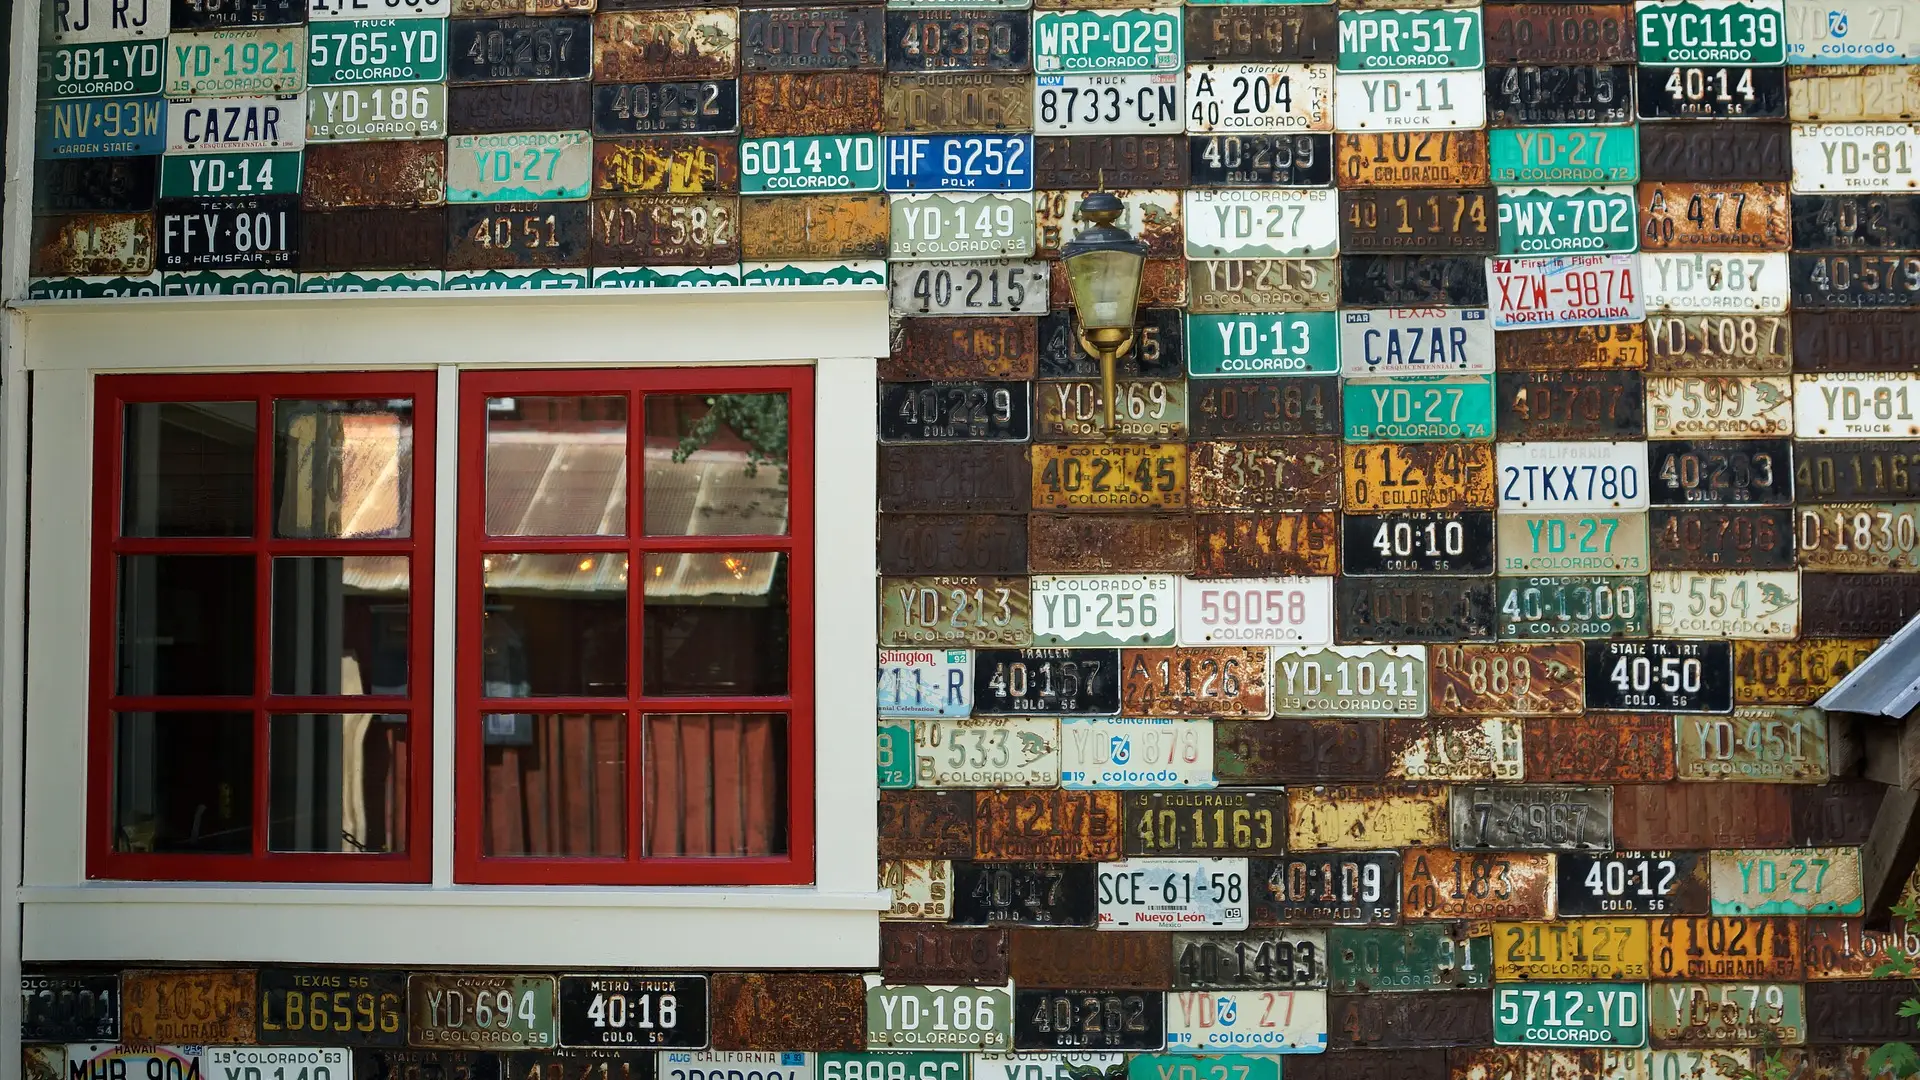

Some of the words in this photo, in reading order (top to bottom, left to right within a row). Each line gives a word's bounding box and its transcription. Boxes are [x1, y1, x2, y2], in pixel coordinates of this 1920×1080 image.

[354, 19, 396, 28] TRUCK
[1642, 13, 1777, 47] EYC1139
[1822, 43, 1895, 53] colorado
[1668, 49, 1751, 60] COLORADO
[1066, 56, 1148, 68] COLORADO
[1367, 55, 1449, 66] COLORADO
[335, 67, 413, 80] COLORADO
[1241, 64, 1289, 74] Colorful
[195, 78, 272, 91] COLORADO
[918, 74, 992, 86] COLORADO
[1040, 77, 1061, 86] NOV
[1089, 77, 1127, 85] TRUCK
[58, 80, 134, 94] COLORADO
[1232, 76, 1292, 114] 204
[184, 106, 280, 143] CAZAR
[1224, 117, 1307, 127] COLORADO
[1387, 117, 1430, 125] TRUCK
[335, 122, 415, 135] COLORADO
[1824, 126, 1907, 136] COLORADO
[478, 135, 558, 148] COLORADO
[58, 145, 99, 154] GARDEN
[103, 142, 133, 153] STATE
[890, 139, 929, 175] HF
[944, 139, 1025, 175] 6252
[1374, 167, 1449, 181] COLORADO
[1521, 168, 1604, 179] COLORADO
[767, 176, 849, 188] COLORADO
[941, 178, 976, 187] POLK
[1845, 178, 1889, 187] TRUCK
[1220, 191, 1304, 202] COLORADO
[201, 201, 257, 210] TEXAS
[1687, 192, 1746, 230] 477
[1521, 237, 1604, 249] COLORADO
[1678, 233, 1763, 244] COLORADO
[917, 240, 1002, 252] COLORADO
[194, 254, 263, 264] HEMISFAIR
[1521, 259, 1547, 268] First
[1571, 255, 1603, 266] Flight
[914, 268, 1025, 307] 40-215
[1497, 269, 1635, 311] XZW-9874
[1220, 295, 1303, 304] COLORADO
[1672, 296, 1753, 307] COLORADO
[1348, 315, 1369, 323] MAR
[1505, 311, 1554, 322] NORTH
[1560, 307, 1629, 319] CAROLINA
[1364, 326, 1467, 365] CAZAR
[1222, 358, 1306, 371] COLORADO
[1683, 378, 1744, 418] 599
[1376, 425, 1460, 436] COLORADO
[1677, 420, 1760, 432] COLORADO
[1846, 424, 1890, 432] TRUCK
[1531, 448, 1610, 458] CALIFORNIA
[1505, 465, 1638, 501] 2TKX780
[1069, 494, 1150, 504] COLORADO
[1382, 490, 1457, 504] COLORADO
[1530, 557, 1613, 568] COLORADO
[934, 577, 977, 585] TRUCK
[1056, 580, 1142, 591] COLORADO
[1530, 577, 1609, 585] COLORFUL
[1688, 577, 1749, 617] 554
[1201, 590, 1305, 625] 59058
[1530, 623, 1611, 634] COLORADO
[1680, 618, 1764, 631] COLORADO
[1212, 629, 1297, 640] COLORADO
[1611, 644, 1645, 654] STATE
[1159, 659, 1239, 697] 1126
[1468, 657, 1532, 695] 889
[1307, 698, 1393, 709] COLORADO
[949, 729, 1009, 768] 533
[1711, 763, 1792, 774] COLORADO
[941, 772, 1024, 782] COLORADO
[1102, 769, 1177, 782] colorado
[1166, 795, 1243, 806] COLORADO
[1451, 859, 1513, 899] 183
[1100, 872, 1242, 905] SCE-61-58
[1284, 907, 1361, 918] COLORADO
[1443, 903, 1530, 914] COLORADO
[1135, 912, 1173, 922] Nuevo
[1175, 911, 1206, 922] León
[1687, 918, 1768, 956] 1027
[1507, 926, 1632, 962] 21T127
[1531, 964, 1610, 974] COLORADO
[1688, 959, 1765, 975] COLORADO
[294, 976, 340, 987] TEXAS
[640, 981, 676, 991] TRUCK
[156, 1023, 228, 1039] COLORADO
[441, 1030, 522, 1042] COLORADO
[1526, 1029, 1611, 1041] COLORADO
[893, 1032, 980, 1043] COLORADO
[1209, 1031, 1285, 1043] colorado
[115, 1045, 156, 1054] HAWAII
[237, 1052, 318, 1063] COLORADO
[669, 1053, 690, 1062] AUG
[697, 1051, 776, 1062] CALIFORNIA
